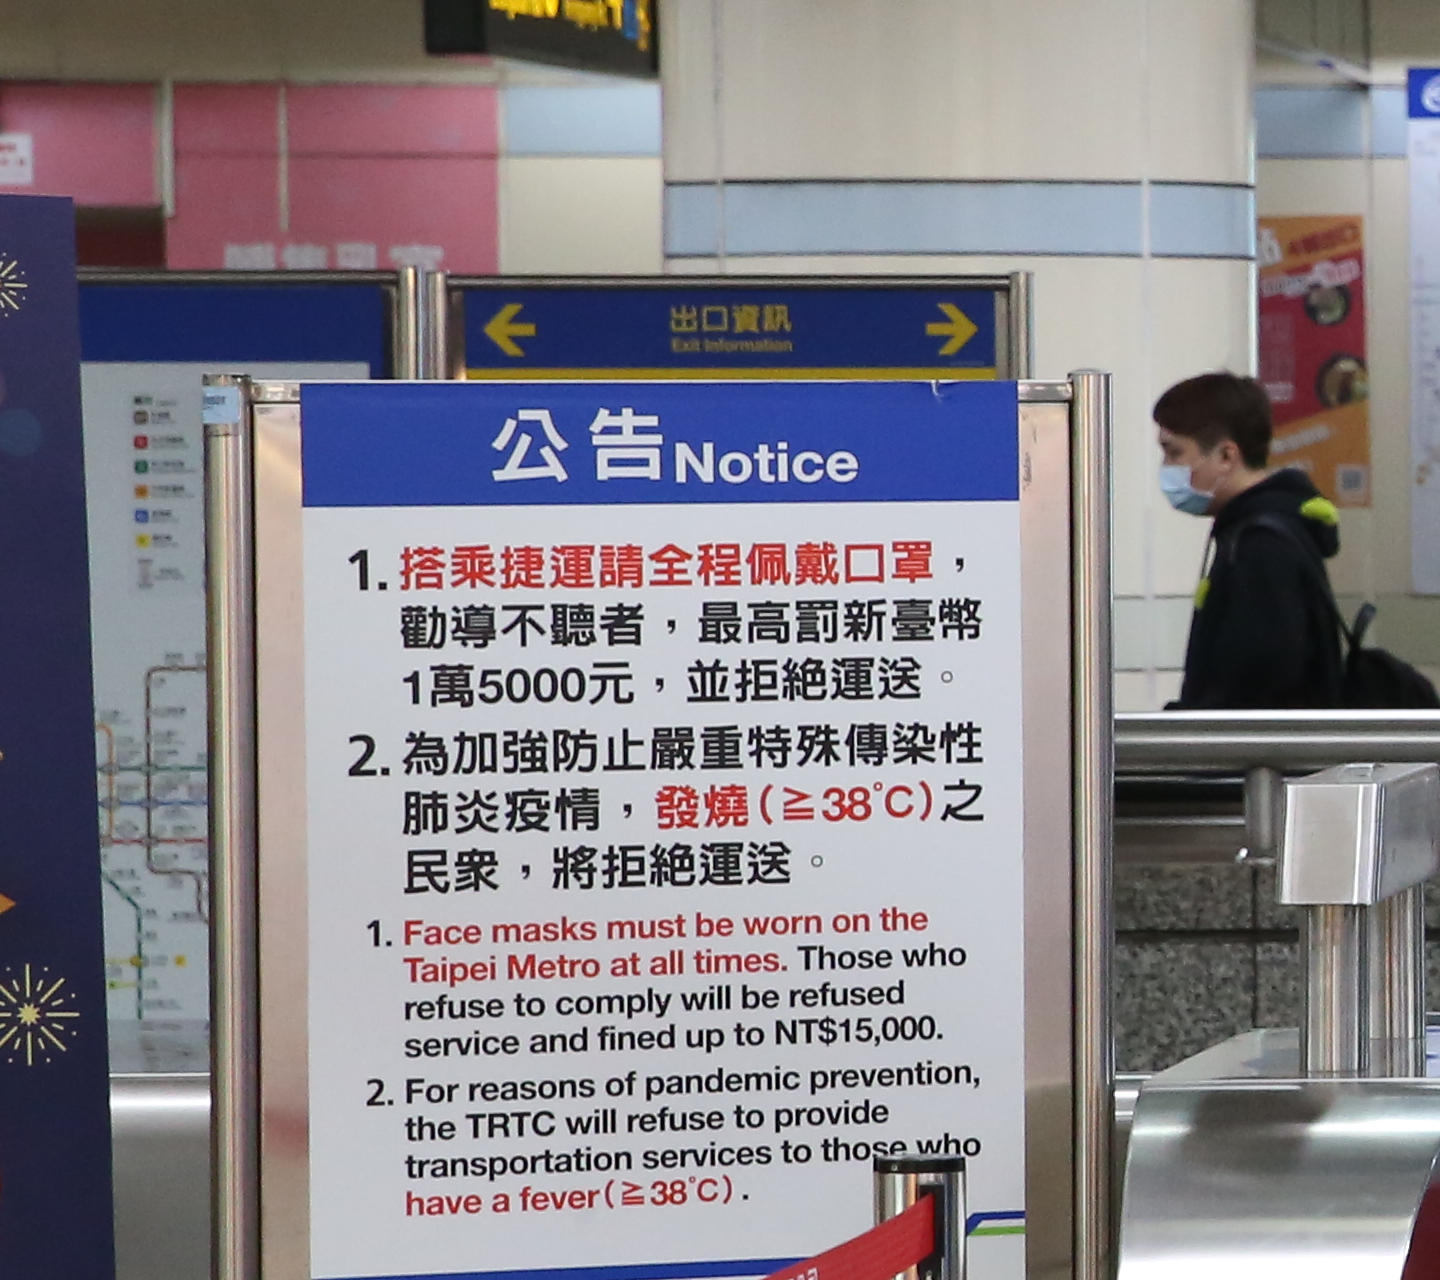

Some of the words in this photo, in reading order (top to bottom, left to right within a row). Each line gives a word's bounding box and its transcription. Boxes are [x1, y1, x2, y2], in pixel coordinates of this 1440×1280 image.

[670, 338, 700, 352] Exit
[704, 338, 793, 352] Information
[491, 407, 666, 484] 公告
[675, 442, 858, 484] Notice
[347, 548, 388, 591] 1.
[347, 734, 391, 778] 2.
[402, 721, 984, 777] 為加強防止嚴重特殊傳染性
[367, 919, 393, 948] 1.
[404, 919, 482, 946] Face
[492, 915, 598, 944] masks
[607, 913, 687, 940] must
[695, 911, 734, 938] be
[743, 914, 823, 936] worn
[831, 913, 871, 934] on
[878, 906, 929, 932] the
[403, 955, 497, 988] Taipei
[507, 953, 601, 981] Metro
[610, 952, 641, 978] at
[649, 949, 684, 976] all
[692, 948, 788, 975] times.
[796, 944, 894, 971] Those
[901, 941, 967, 968] who
[404, 993, 505, 1021] refuse
[513, 992, 546, 1018] to
[555, 987, 673, 1020] comply
[680, 984, 732, 1012] will
[741, 984, 780, 1010] be
[789, 979, 905, 1008] refused
[404, 1029, 520, 1059] service
[529, 1026, 589, 1054] and
[596, 1023, 676, 1052] fined
[685, 1028, 725, 1054] up
[732, 1022, 765, 1047] to
[775, 1014, 944, 1048] NT$15,000.
[366, 1078, 394, 1107] 2.
[405, 1077, 460, 1105] For
[468, 1078, 596, 1103] reasons
[604, 1070, 637, 1098] of
[645, 1065, 801, 1102] pandemic
[810, 1059, 981, 1096] prevention,
[404, 1115, 457, 1142] the
[464, 1110, 556, 1140] TRTC
[565, 1107, 617, 1136] will
[627, 1106, 725, 1134] refuse
[732, 1104, 765, 1129] to
[774, 1098, 890, 1134] provide
[404, 1146, 633, 1183] transportation
[642, 1141, 773, 1170] services
[780, 1139, 813, 1164] to
[820, 1137, 908, 1162] those
[915, 1132, 982, 1158] who
[405, 1190, 483, 1217] have
[491, 1193, 511, 1214] a
